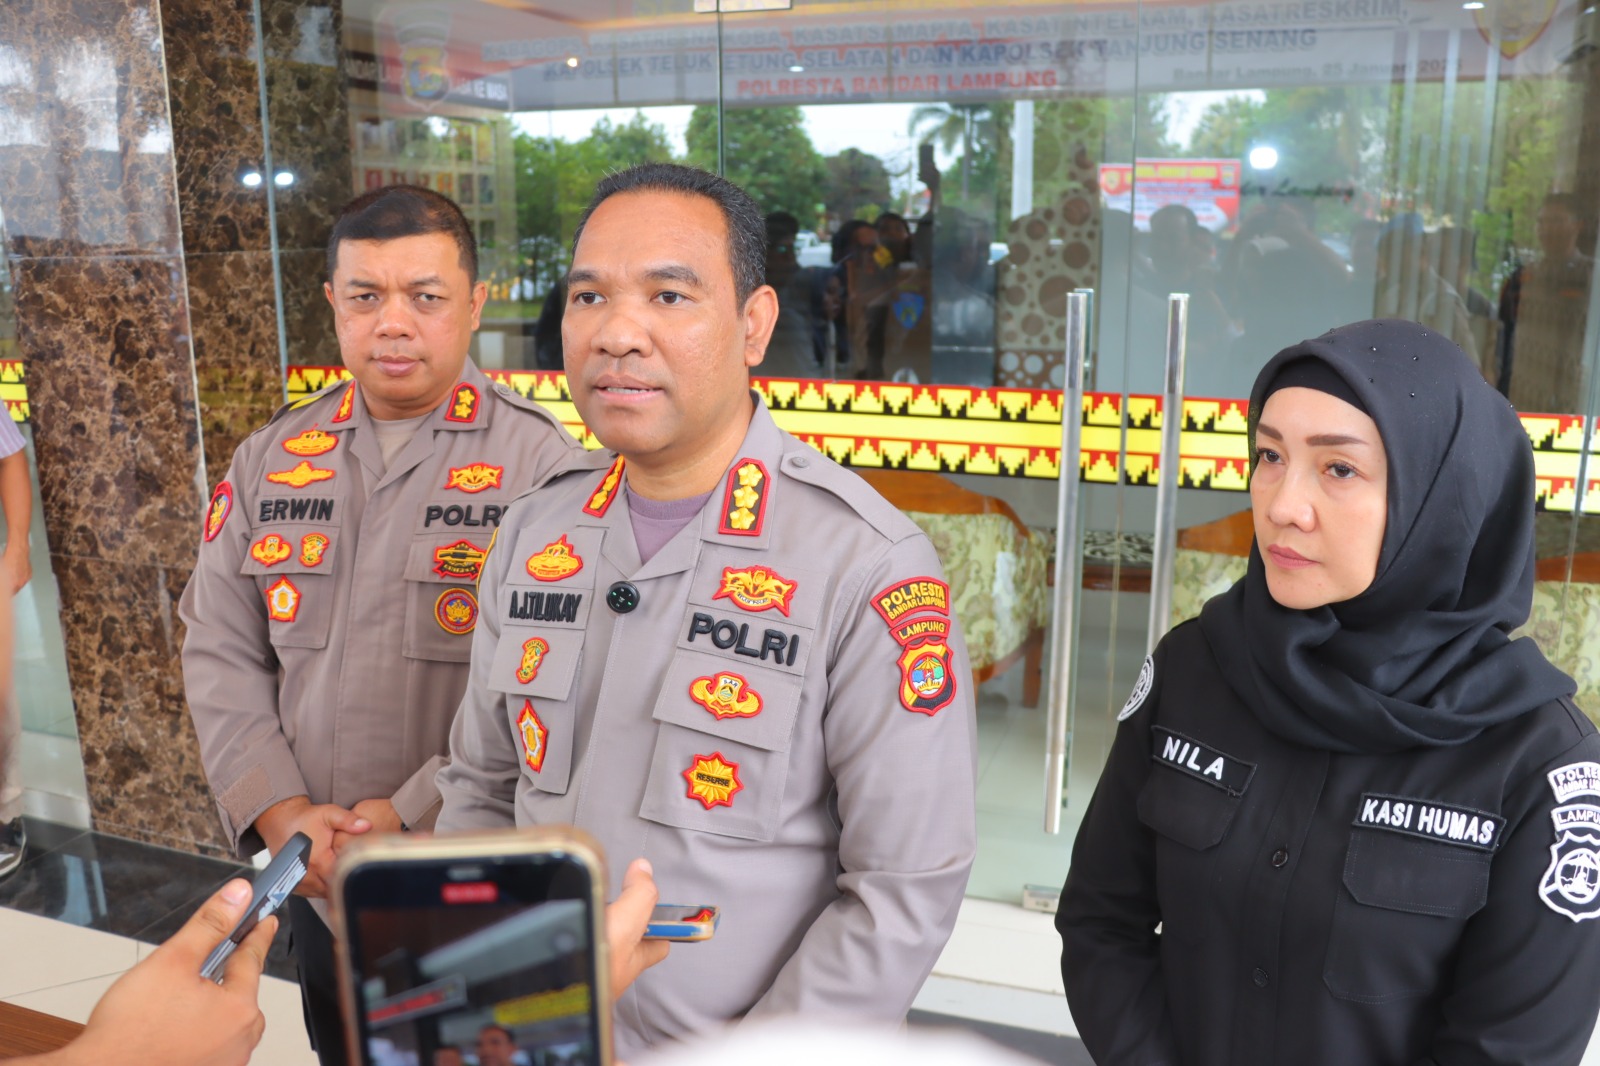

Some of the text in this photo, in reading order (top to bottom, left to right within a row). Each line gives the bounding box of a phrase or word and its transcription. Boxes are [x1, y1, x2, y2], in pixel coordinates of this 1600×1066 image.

[722, 51, 795, 70] ETUNG
[803, 48, 902, 68] SELATAN
[909, 45, 953, 64] DAN
[1215, 28, 1317, 50] SENANG
[738, 76, 846, 96] POLRESTA
[947, 69, 1058, 91] LAMPUNG
[258, 499, 335, 523] ERWIN
[880, 582, 945, 612] POLRESTA
[887, 599, 917, 620] BANDAR
[688, 612, 799, 667] POLRI
[898, 621, 945, 640] LAMPUNG
[1162, 736, 1224, 780] NILA
[696, 772, 731, 788] RESERSE
[1361, 798, 1495, 845] KASI HUMAS
[1558, 809, 1600, 824] LAMPU
